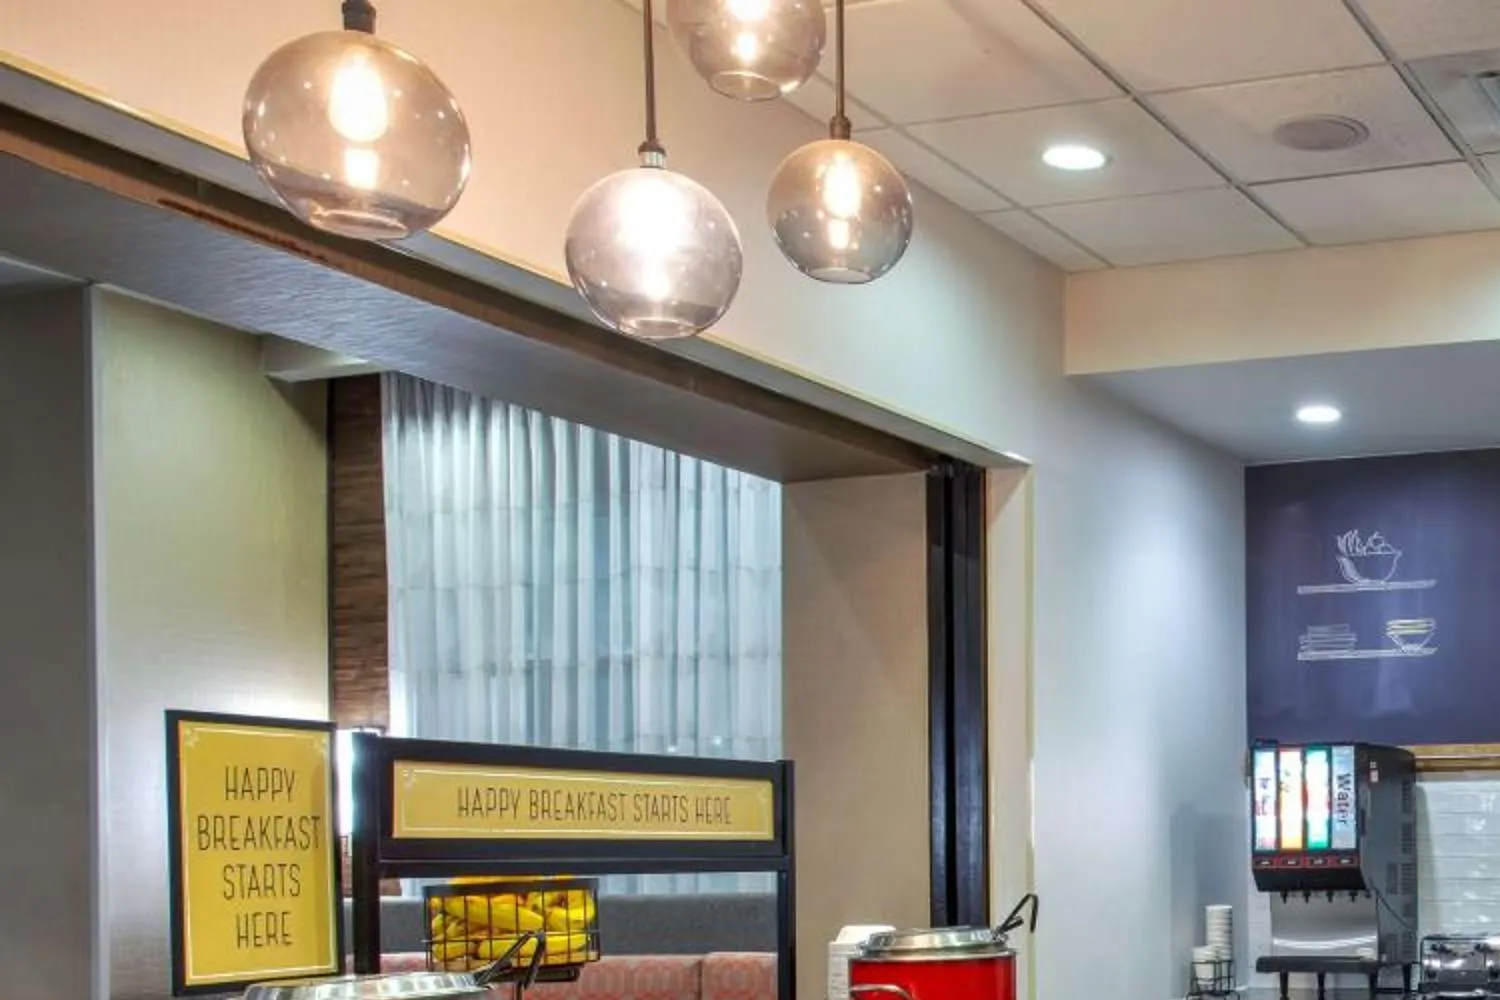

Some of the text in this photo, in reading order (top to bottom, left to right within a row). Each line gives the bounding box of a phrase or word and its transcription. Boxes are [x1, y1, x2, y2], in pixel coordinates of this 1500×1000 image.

[225, 765, 295, 802] HAPPY
[1337, 773, 1352, 825] Water
[457, 787, 734, 826] HAPPY BREAKFAST STARTS HERE
[196, 815, 321, 851] BREAKFAST
[222, 863, 301, 901] STARTS
[235, 911, 294, 949] HERE
